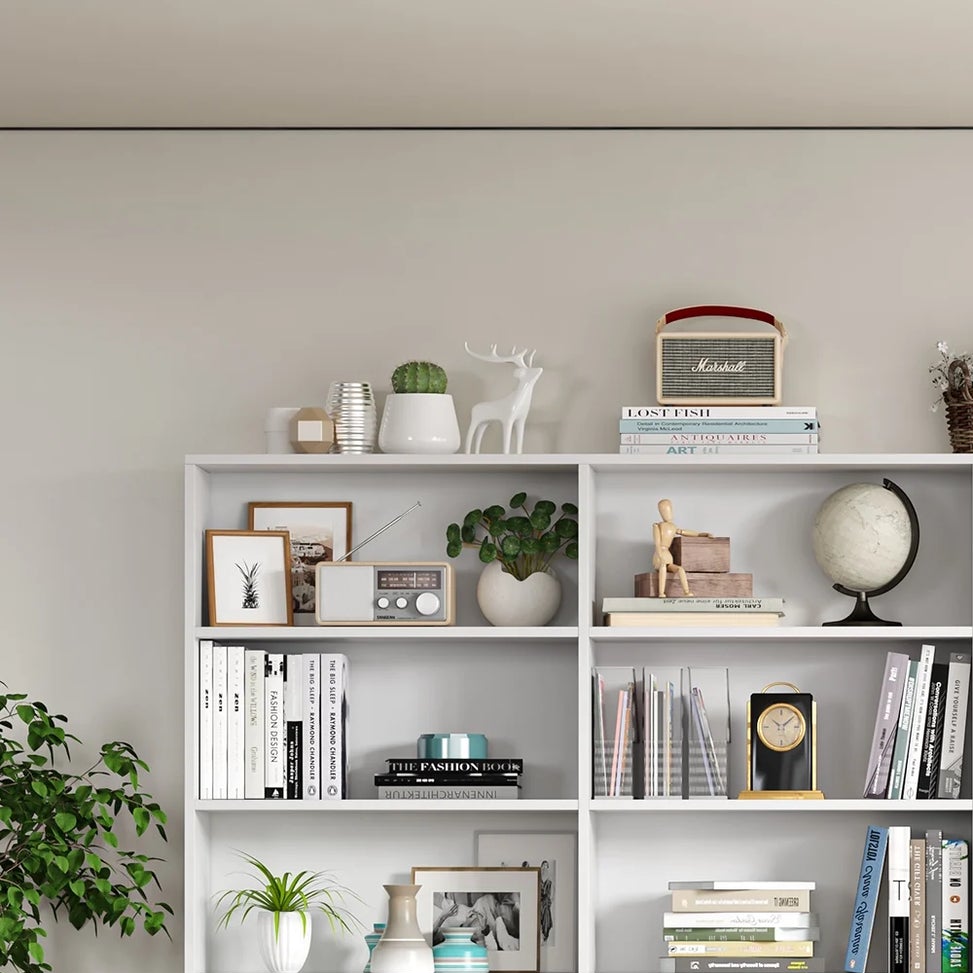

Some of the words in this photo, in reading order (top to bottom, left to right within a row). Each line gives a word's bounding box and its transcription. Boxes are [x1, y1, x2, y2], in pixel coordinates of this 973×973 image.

[692, 358, 746, 372] Marshall
[628, 409, 670, 417] LOST
[931, 682, 942, 728] Conversations
[926, 743, 934, 776] Architects
[392, 763, 418, 771] THE
[420, 763, 479, 771] FASHION
[482, 763, 520, 771] BOOK
[385, 790, 497, 799] INNENARCHITEKTUR
